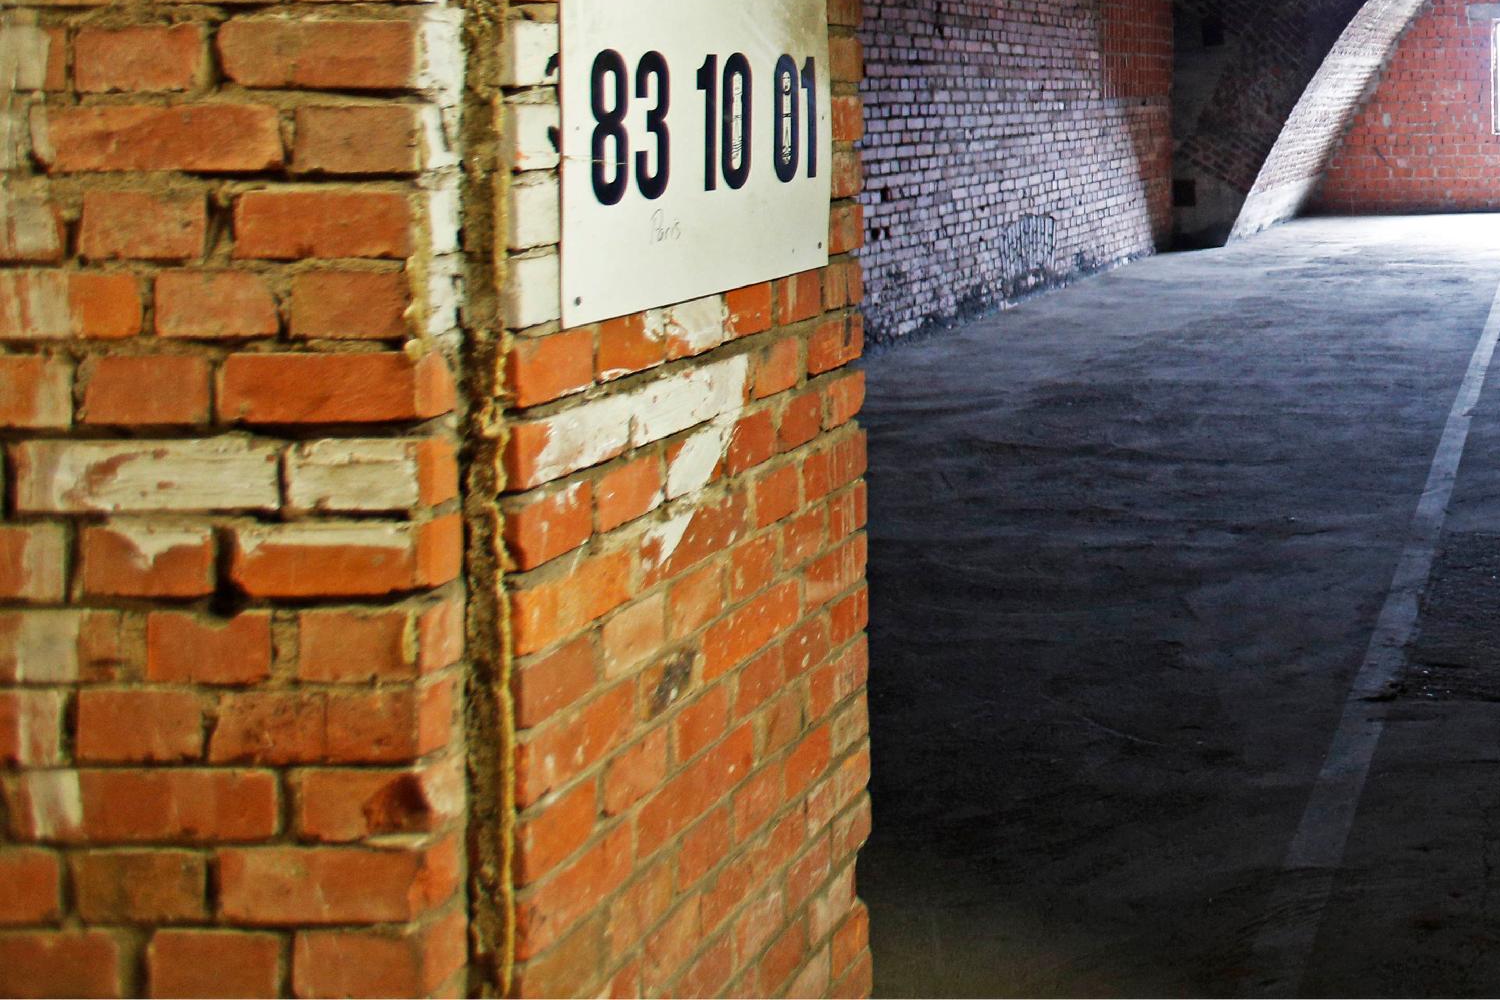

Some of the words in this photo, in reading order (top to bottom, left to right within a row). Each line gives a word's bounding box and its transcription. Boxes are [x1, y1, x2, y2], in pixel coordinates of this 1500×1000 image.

[591, 48, 671, 205] 83
[696, 52, 753, 191] 10
[773, 53, 817, 183] 01
